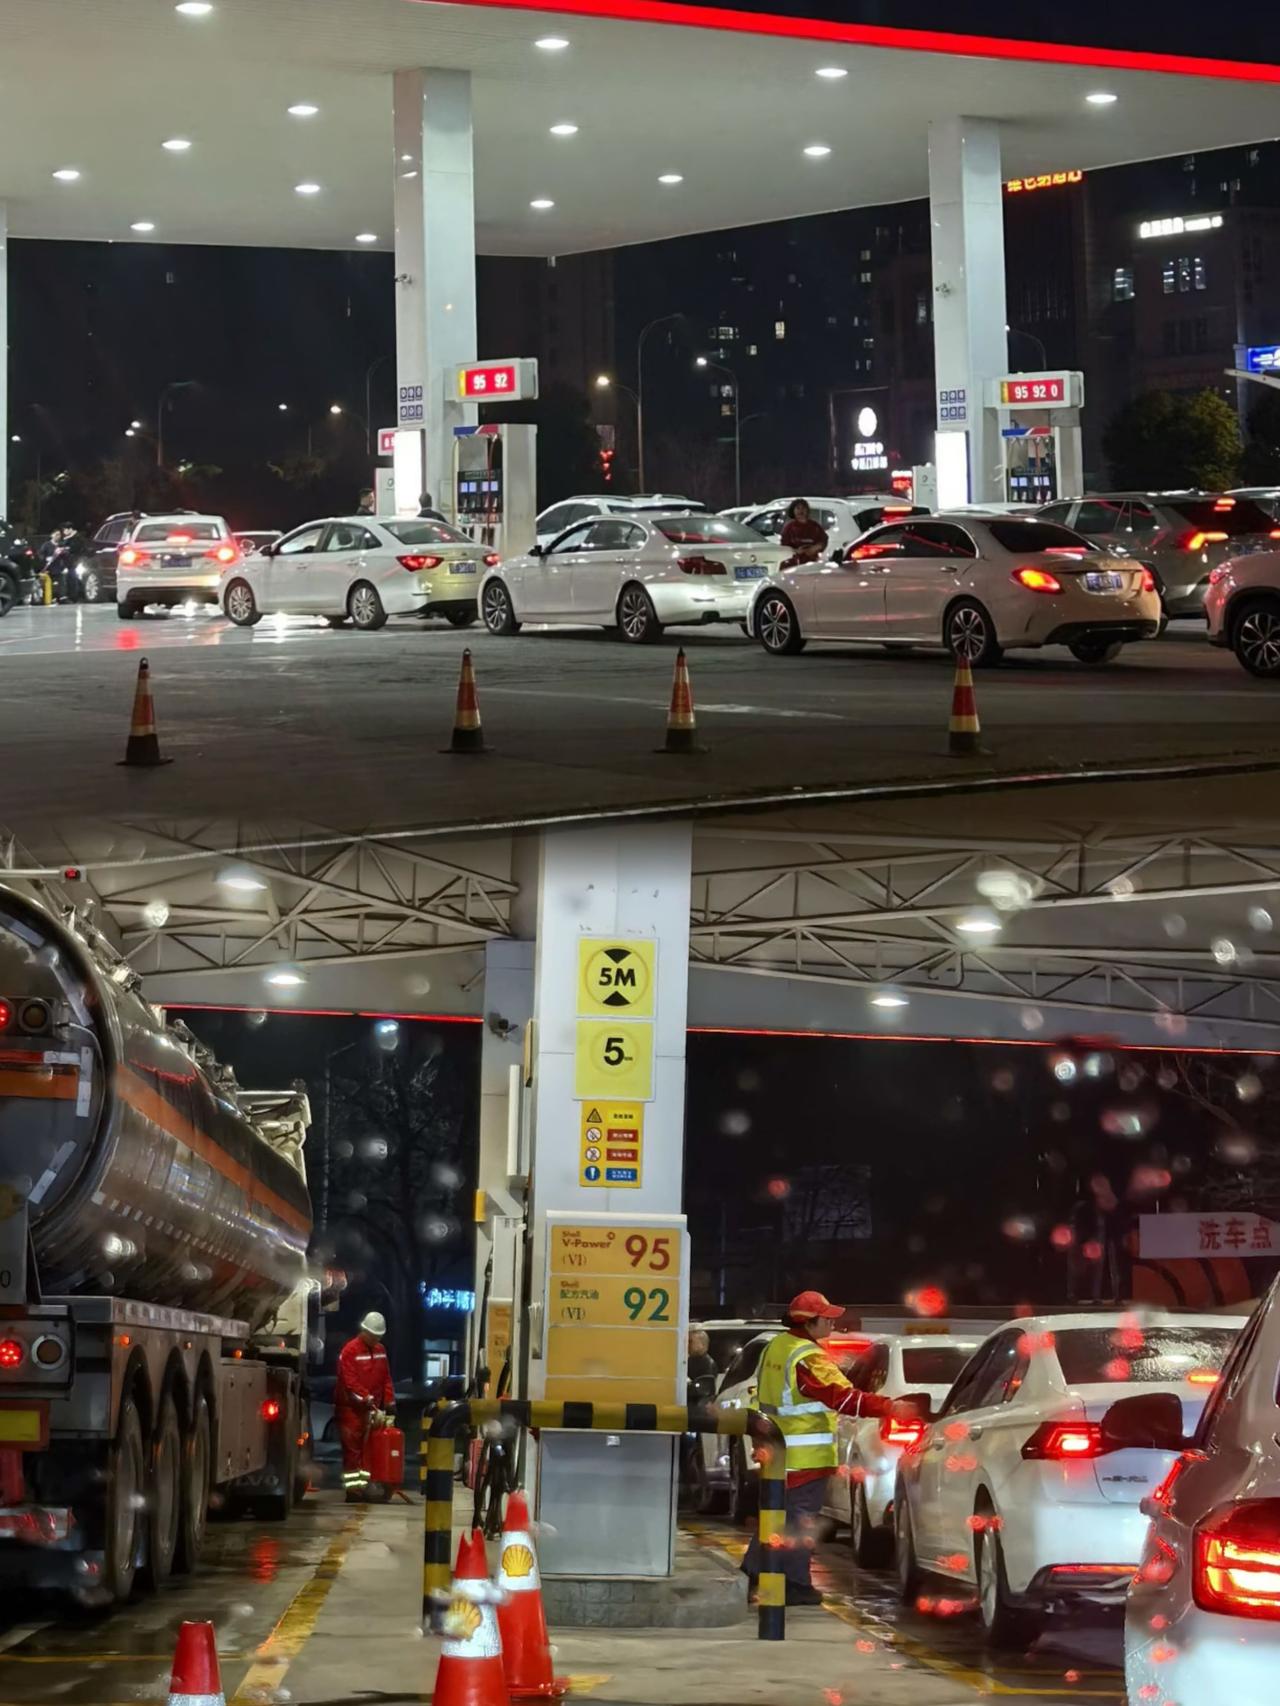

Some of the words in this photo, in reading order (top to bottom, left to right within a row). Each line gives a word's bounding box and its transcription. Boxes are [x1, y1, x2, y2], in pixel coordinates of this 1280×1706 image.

[473, 375, 486, 390] 95
[494, 373, 507, 388] 92
[1015, 385, 1028, 399] 95
[1032, 384, 1046, 398] 92
[1051, 384, 1058, 397] 0
[598, 967, 636, 987] 5M
[603, 1037, 625, 1066] 5
[562, 1238, 612, 1248] V-Power
[1199, 1217, 1274, 1250] 洗车点
[625, 1234, 671, 1271] 95
[560, 1289, 600, 1300] 配方汽油
[623, 1287, 670, 1322] 92
